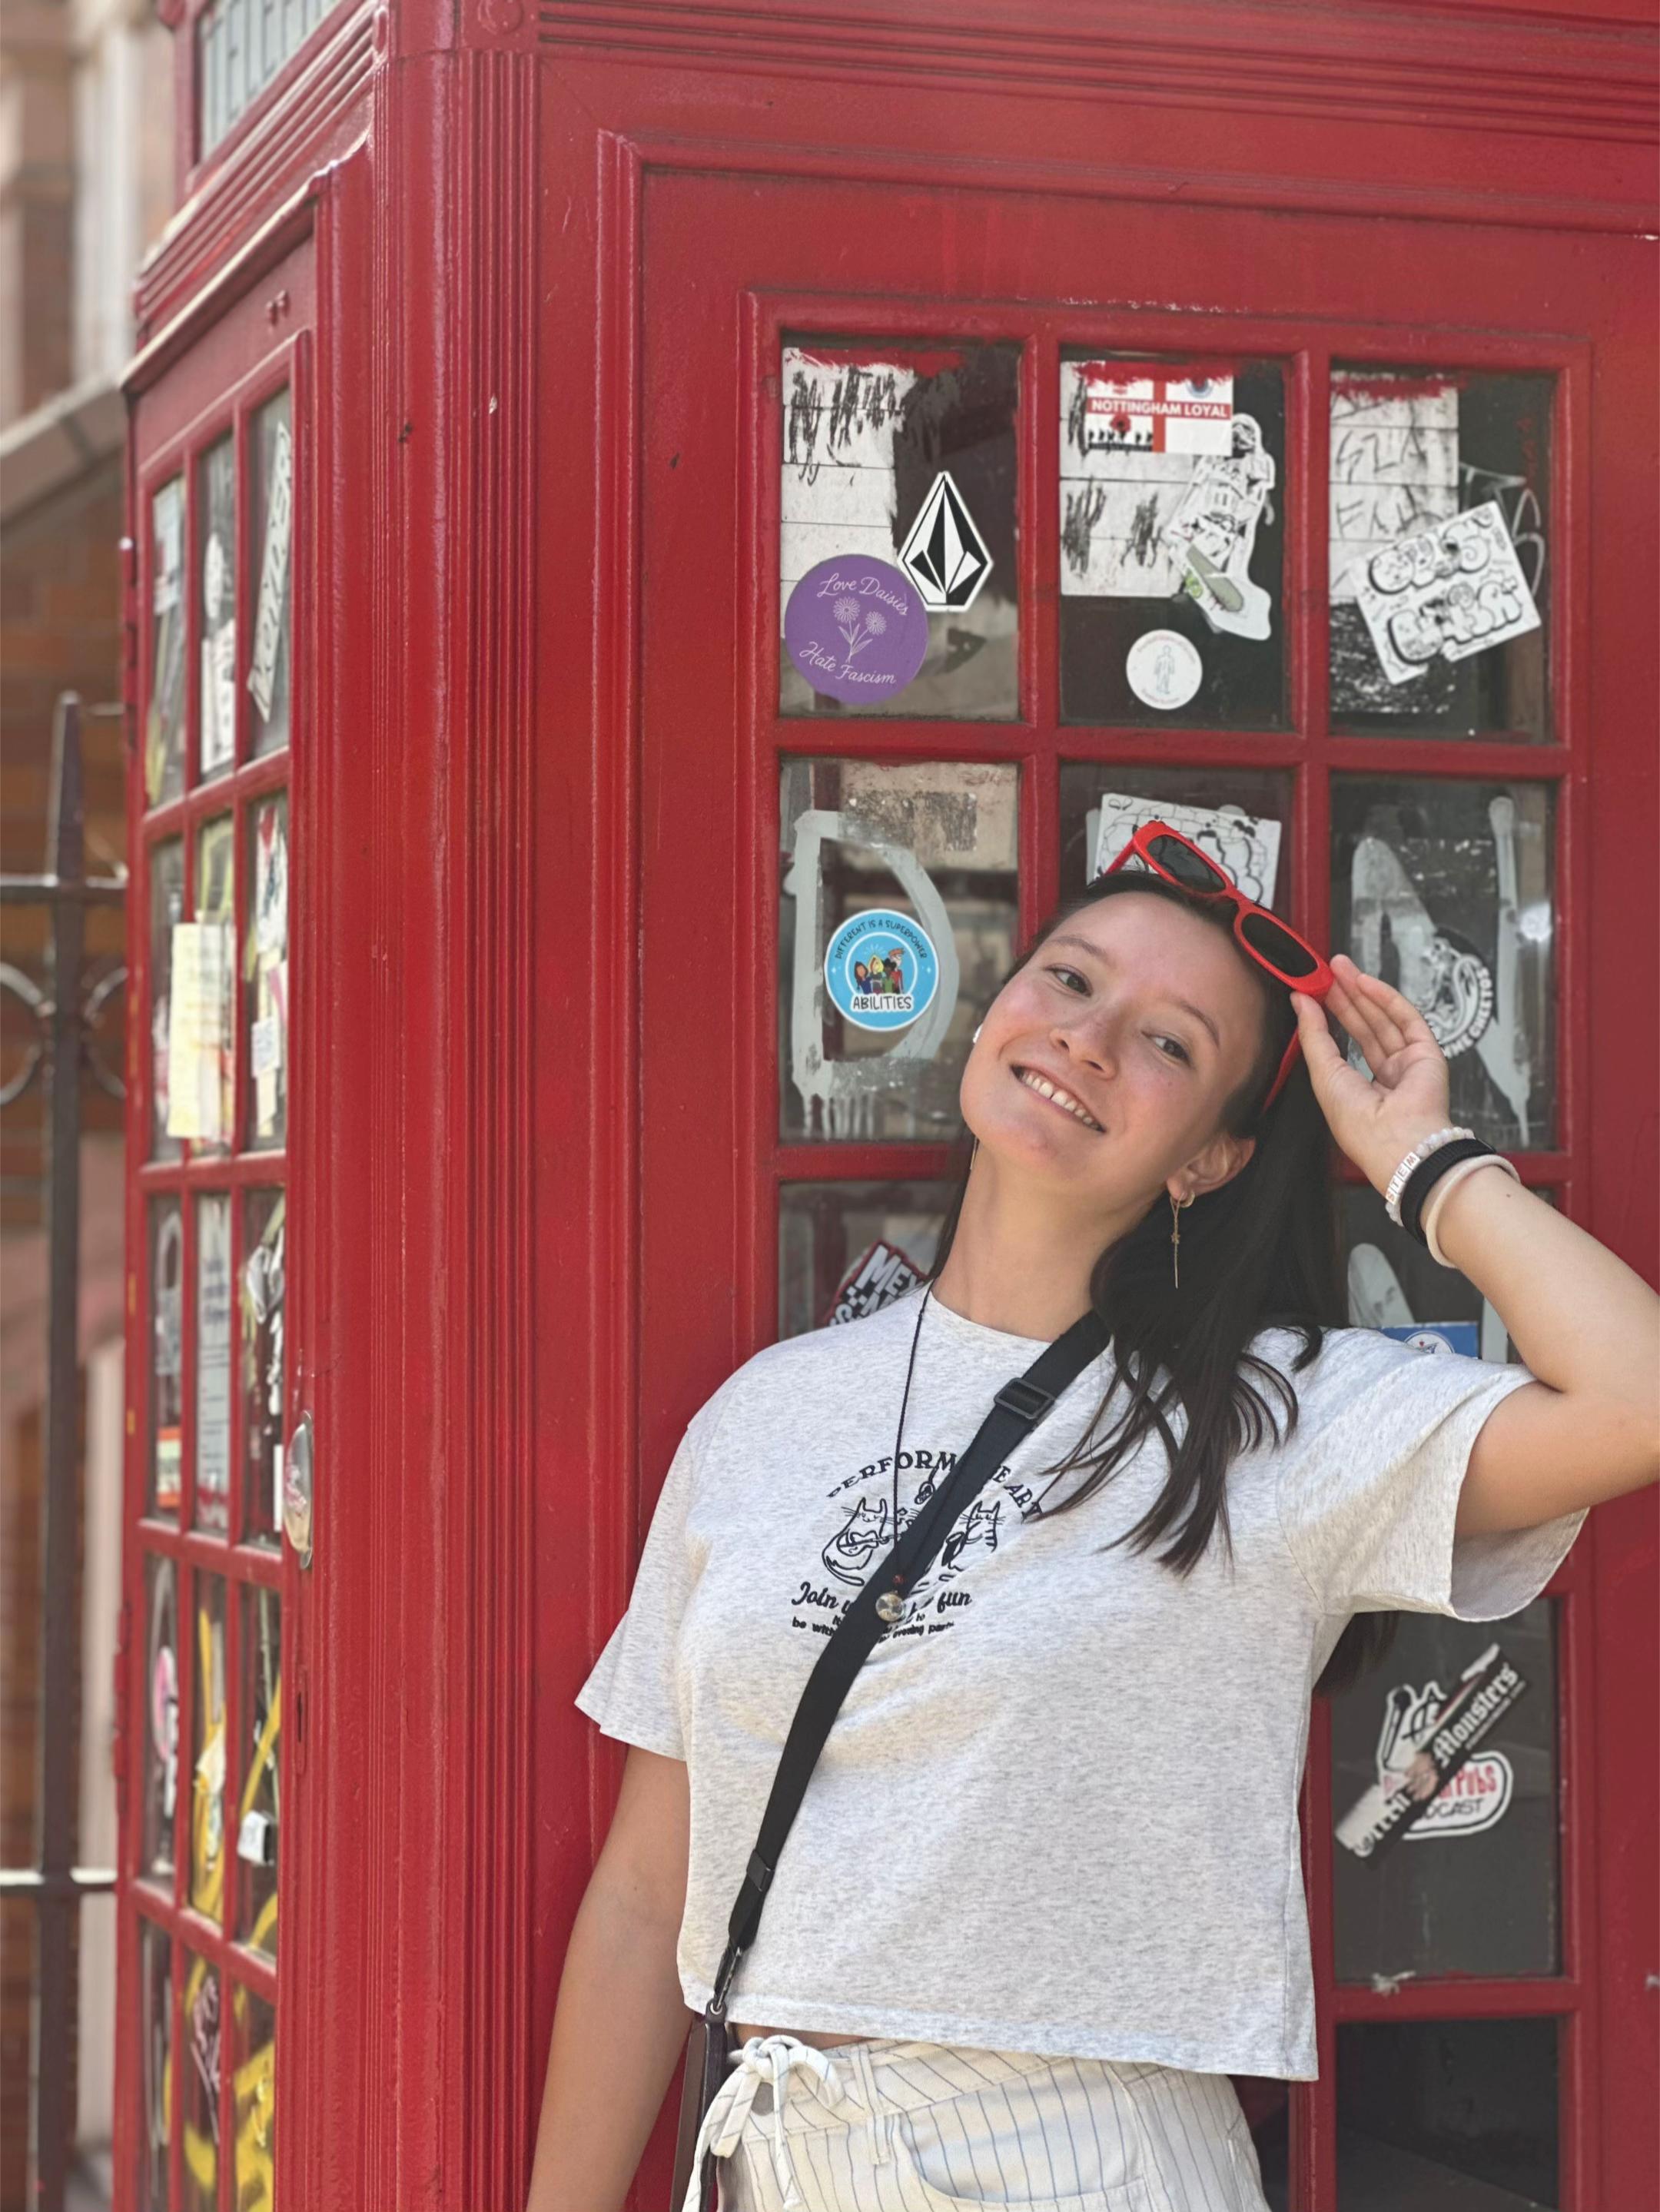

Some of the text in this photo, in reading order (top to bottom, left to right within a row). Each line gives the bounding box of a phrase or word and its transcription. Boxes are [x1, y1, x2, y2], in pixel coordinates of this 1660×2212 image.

[1091, 399, 1227, 417] NOTTINGHAM LOYAL
[816, 572, 909, 616] Love Daisies
[799, 641, 897, 684] Hate Fascism
[835, 922, 866, 959] DIFFERENT
[868, 919, 876, 928] IS
[885, 919, 928, 958] SUPERPOWER
[853, 995, 912, 1010] ABILITIES
[792, 1581, 839, 1609] Join
[937, 1592, 973, 1613] fun
[792, 1616, 807, 1629] be
